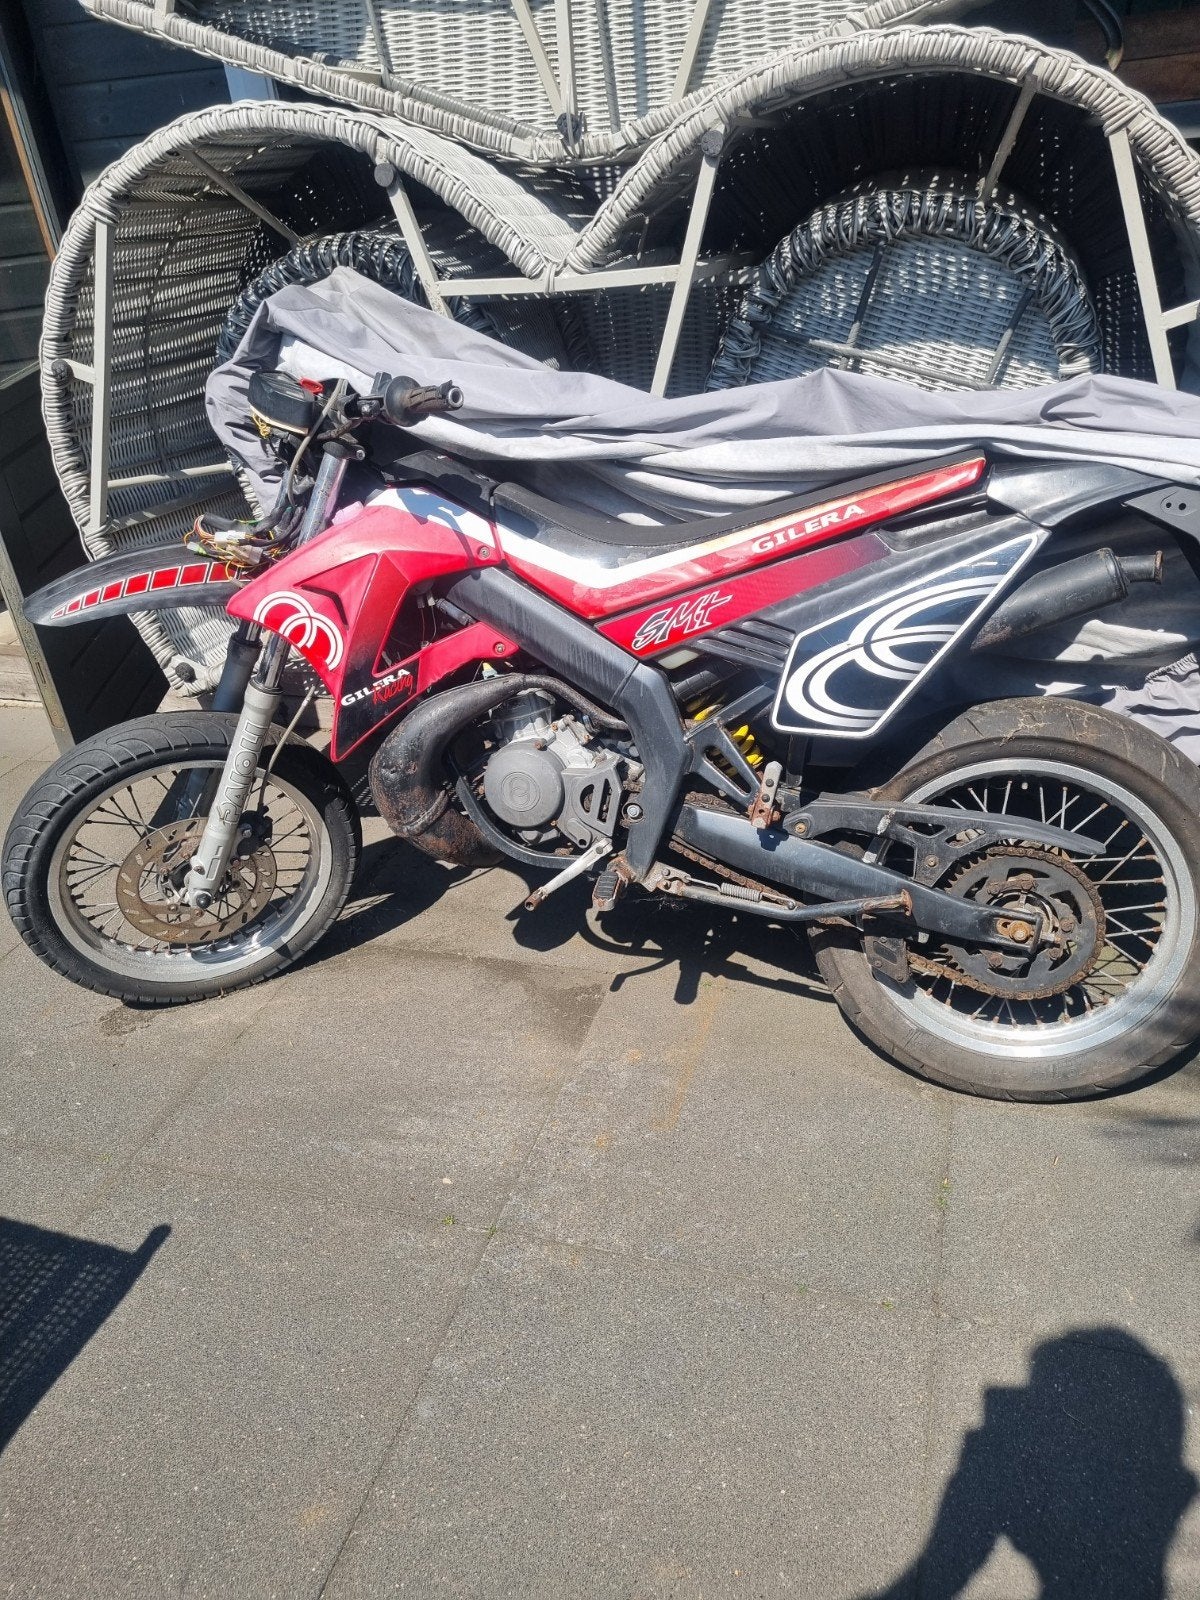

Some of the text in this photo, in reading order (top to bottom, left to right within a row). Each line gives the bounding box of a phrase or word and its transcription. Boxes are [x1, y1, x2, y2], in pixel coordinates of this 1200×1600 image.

[751, 504, 865, 554] GILERA
[340, 668, 411, 707] GILERA
[218, 719, 268, 825] PAIOLI
